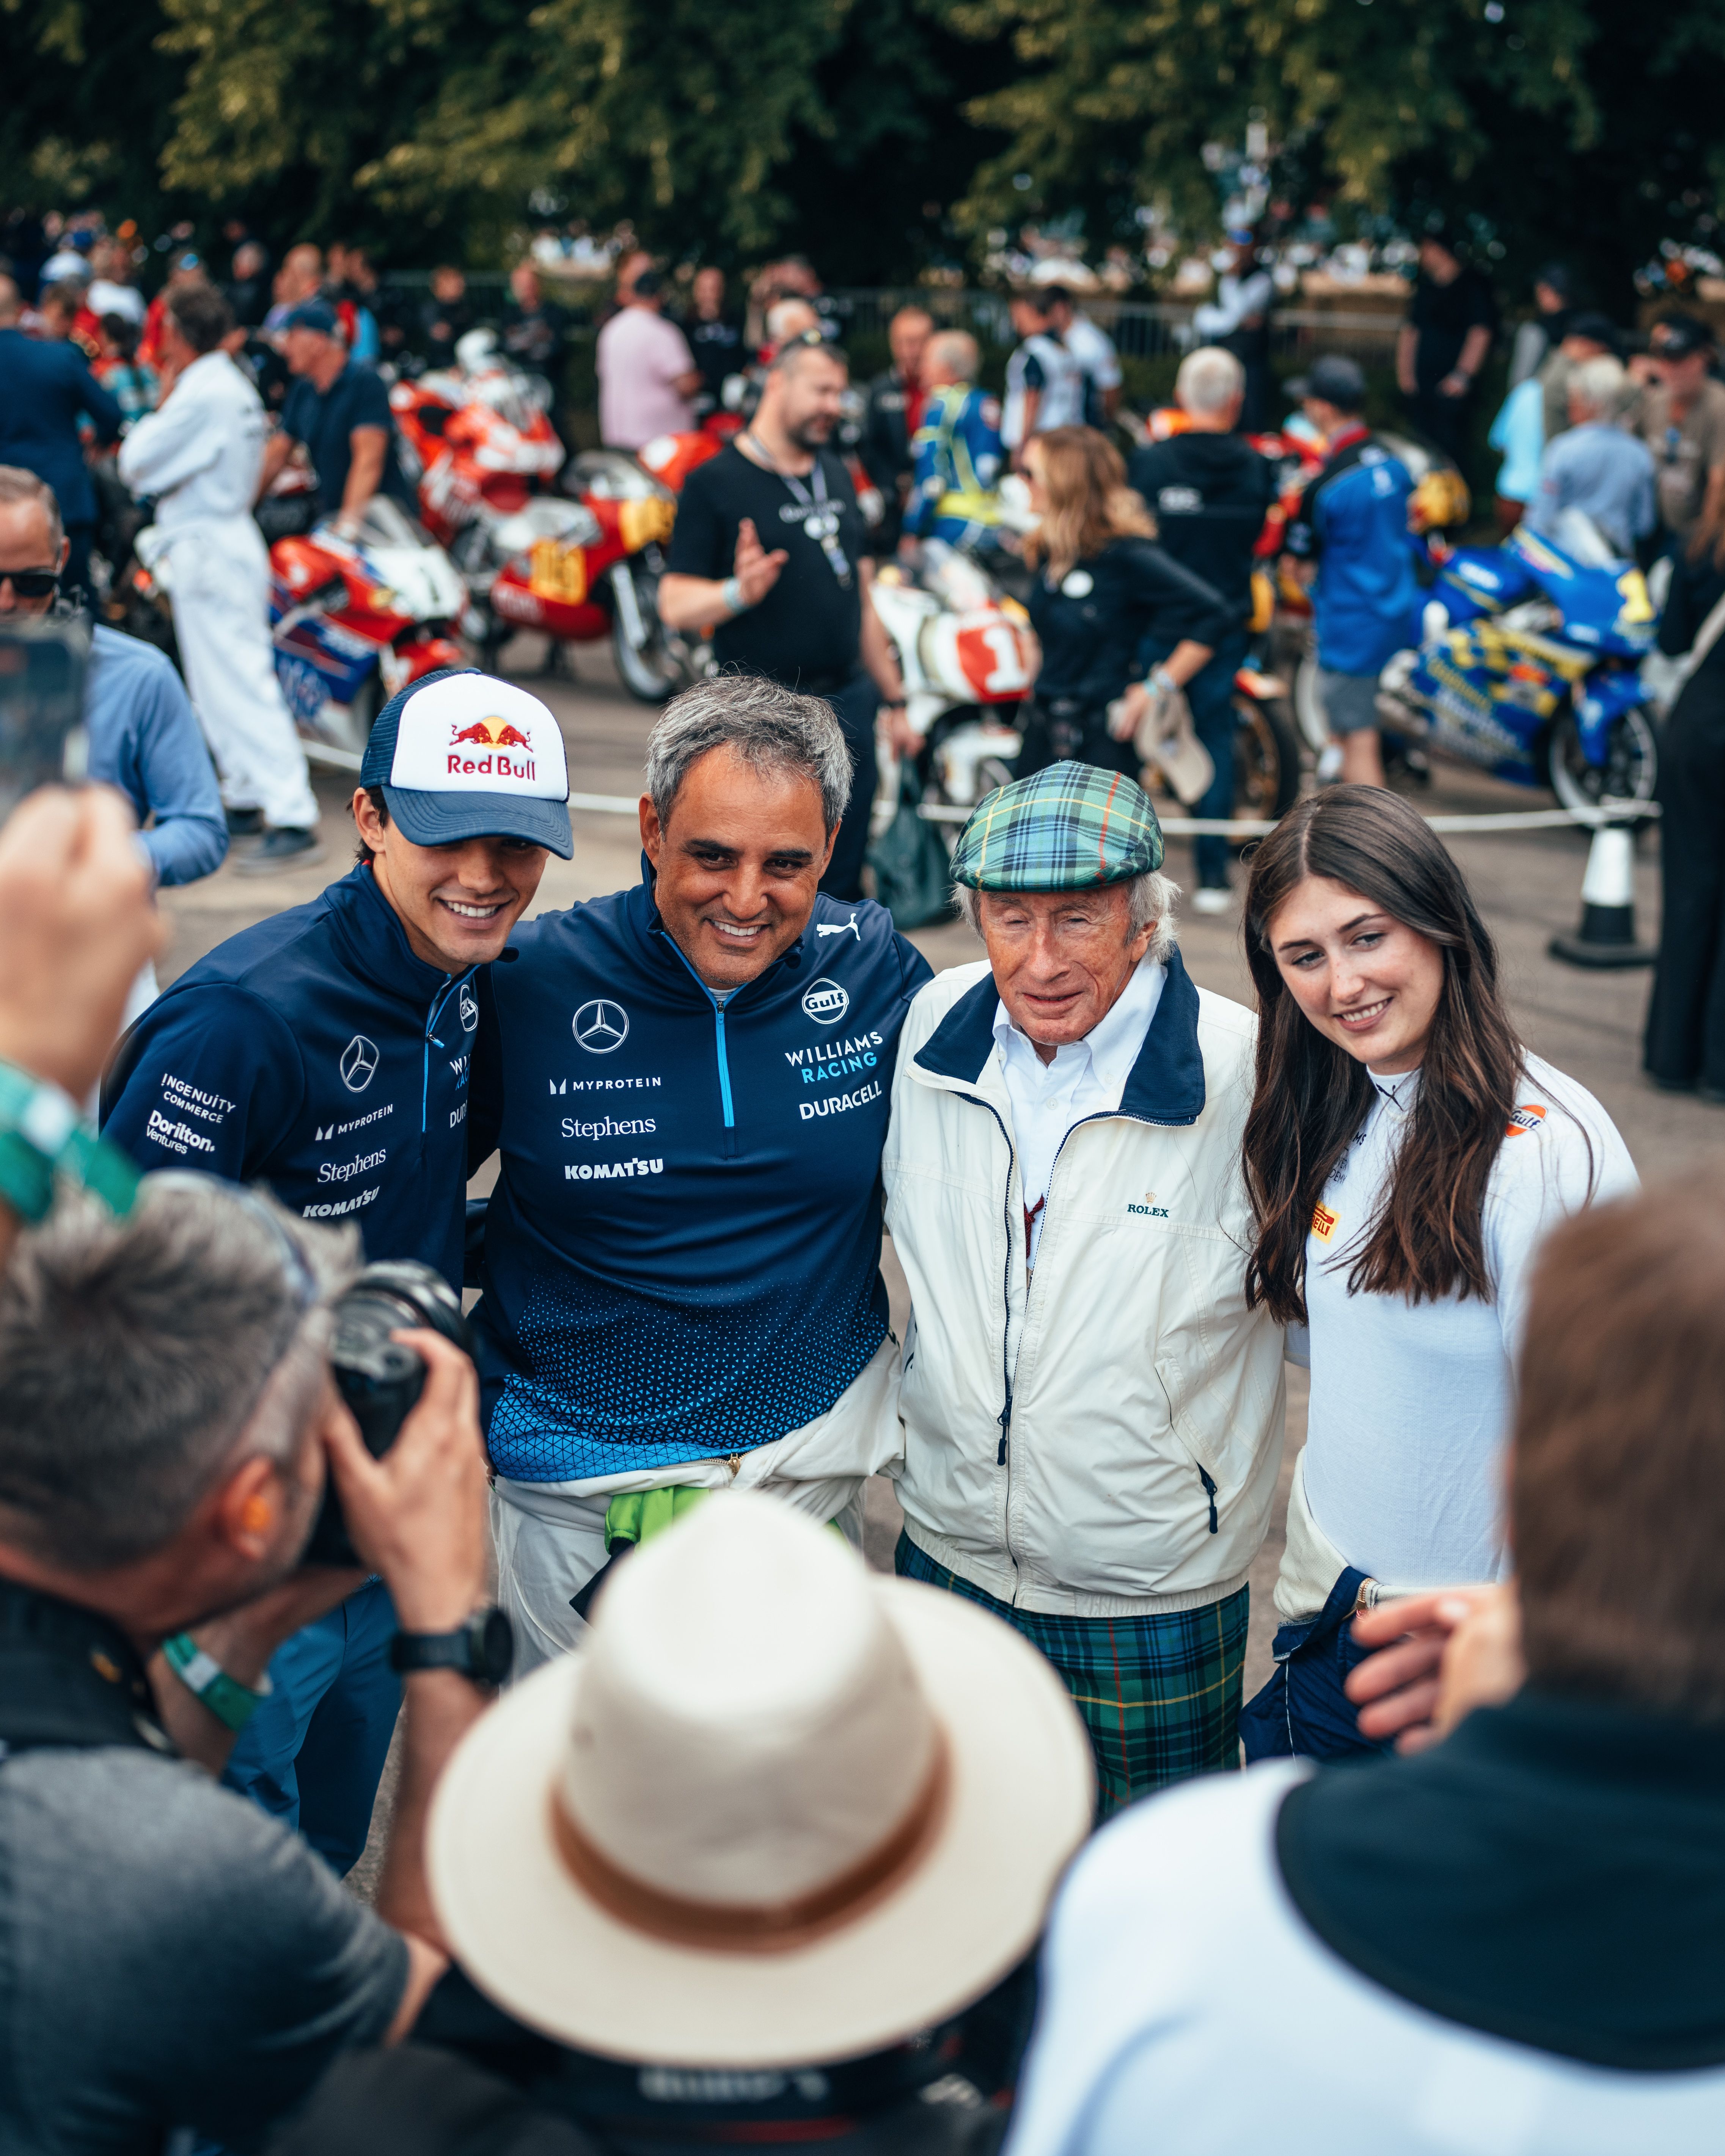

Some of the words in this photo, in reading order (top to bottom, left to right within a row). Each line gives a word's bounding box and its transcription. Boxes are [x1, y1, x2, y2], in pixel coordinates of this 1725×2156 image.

[448, 755, 492, 774] Red
[497, 756, 535, 781] Bull
[805, 992, 844, 1010] Gulf
[784, 1031, 883, 1067] WILLIAMS
[801, 1052, 877, 1083] RACING
[573, 1077, 661, 1090] MYPROTEIN
[163, 1091, 224, 1123] COMMERCE
[799, 1080, 882, 1120] DURACELL
[338, 1104, 393, 1134] MYPROTEIN
[561, 1115, 657, 1141] Stephens
[146, 1125, 188, 1154] Ventures
[317, 1148, 386, 1182] Stephens
[564, 1157, 664, 1179] KOMATSU
[302, 1186, 380, 1217] KOMATSU
[1127, 1204, 1169, 1218] ROLEX
